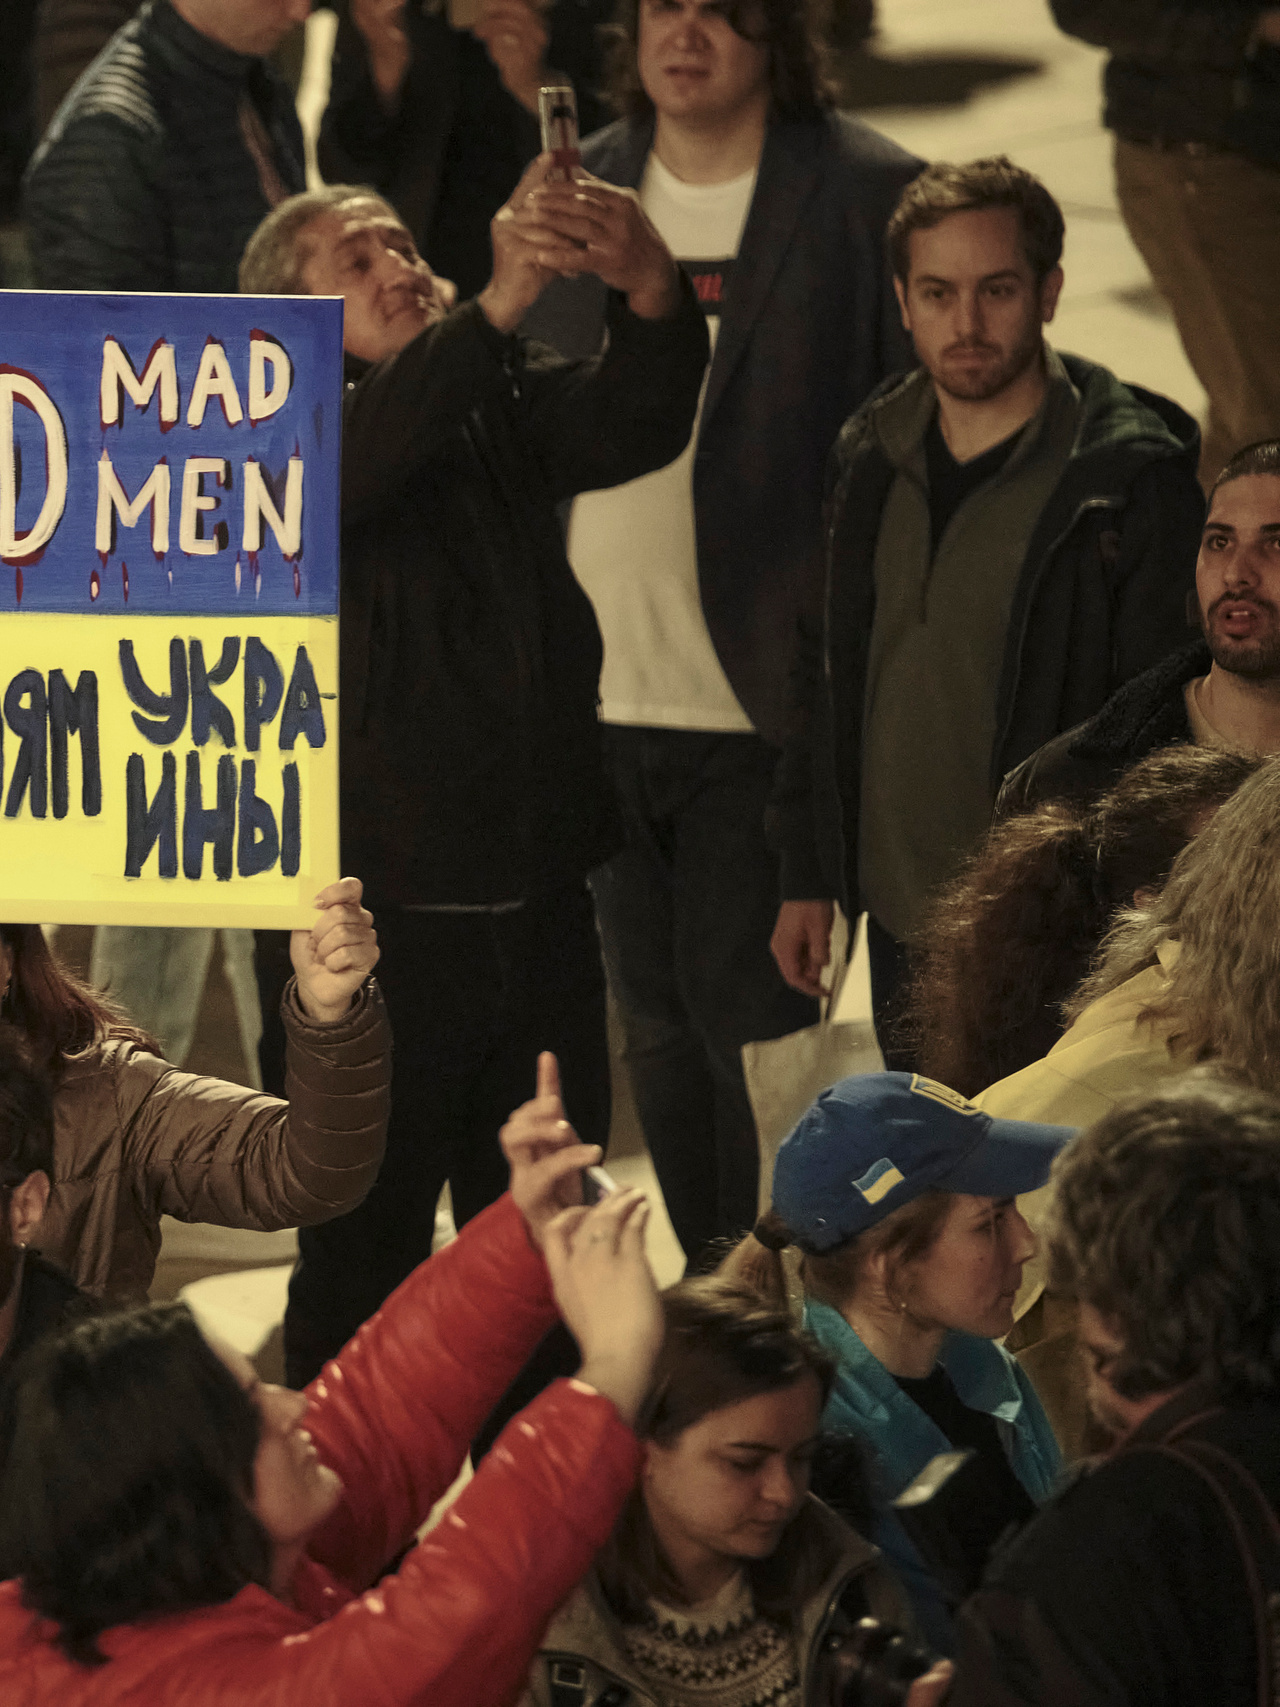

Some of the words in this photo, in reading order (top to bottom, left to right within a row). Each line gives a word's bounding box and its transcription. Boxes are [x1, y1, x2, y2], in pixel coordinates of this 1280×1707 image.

[99, 329, 292, 432] MAD
[95, 446, 304, 560] MEN
[123, 752, 302, 881] ИНЫ
